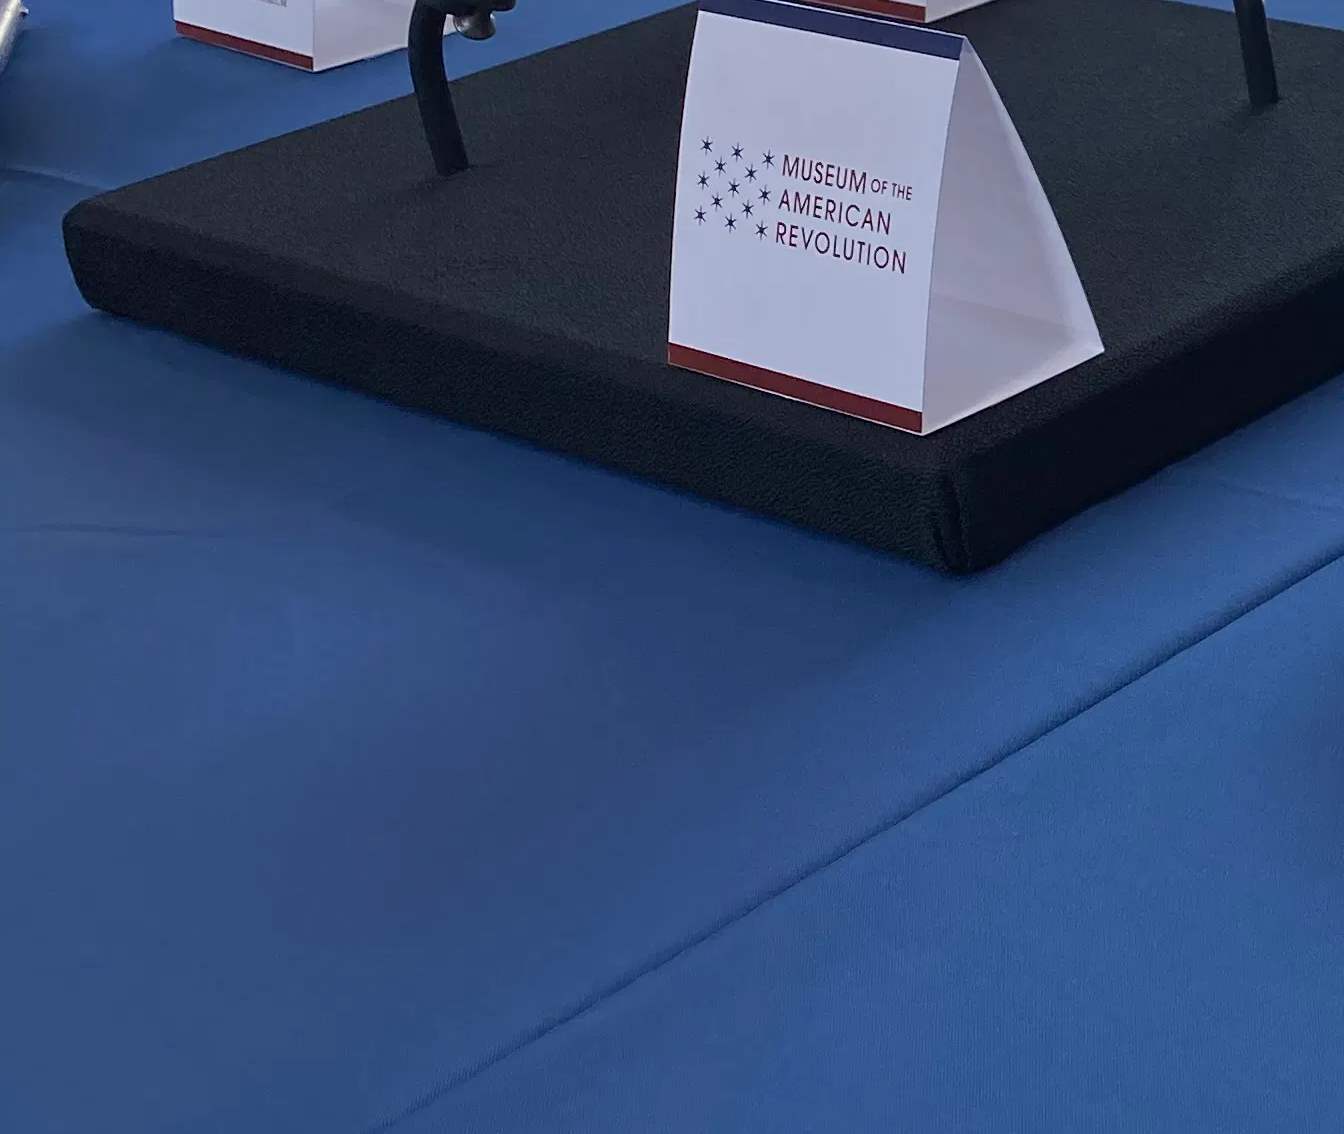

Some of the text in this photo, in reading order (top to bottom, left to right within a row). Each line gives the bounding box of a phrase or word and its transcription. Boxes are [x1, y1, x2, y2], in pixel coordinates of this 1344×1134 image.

[782, 154, 912, 201] MUSEUM OF THE
[778, 188, 891, 235] AMERICAN
[776, 221, 906, 274] REVOLUTION
